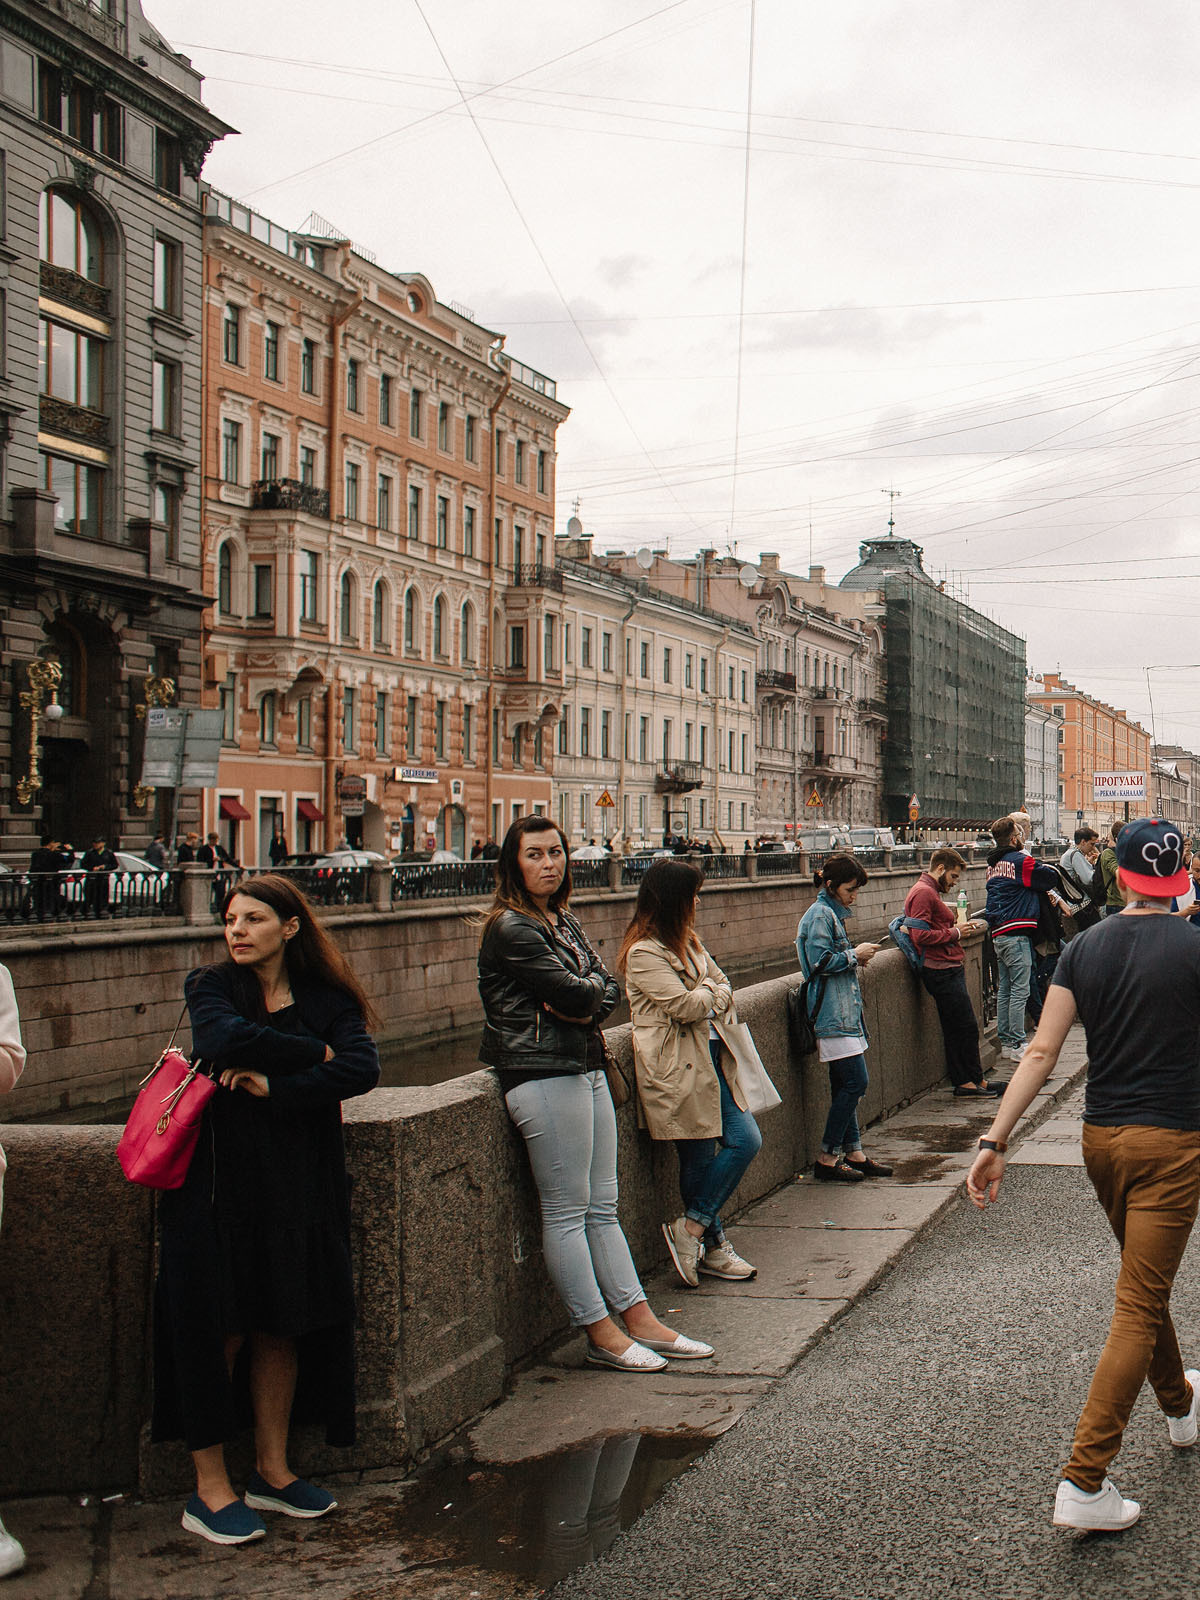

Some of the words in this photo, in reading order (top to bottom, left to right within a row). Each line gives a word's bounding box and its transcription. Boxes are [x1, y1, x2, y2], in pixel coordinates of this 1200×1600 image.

[1094, 775, 1144, 787] ПРОГУЛКИ
[1100, 789, 1117, 797] РЕКАМ
[1120, 789, 1144, 797] КАНАЛАМ
